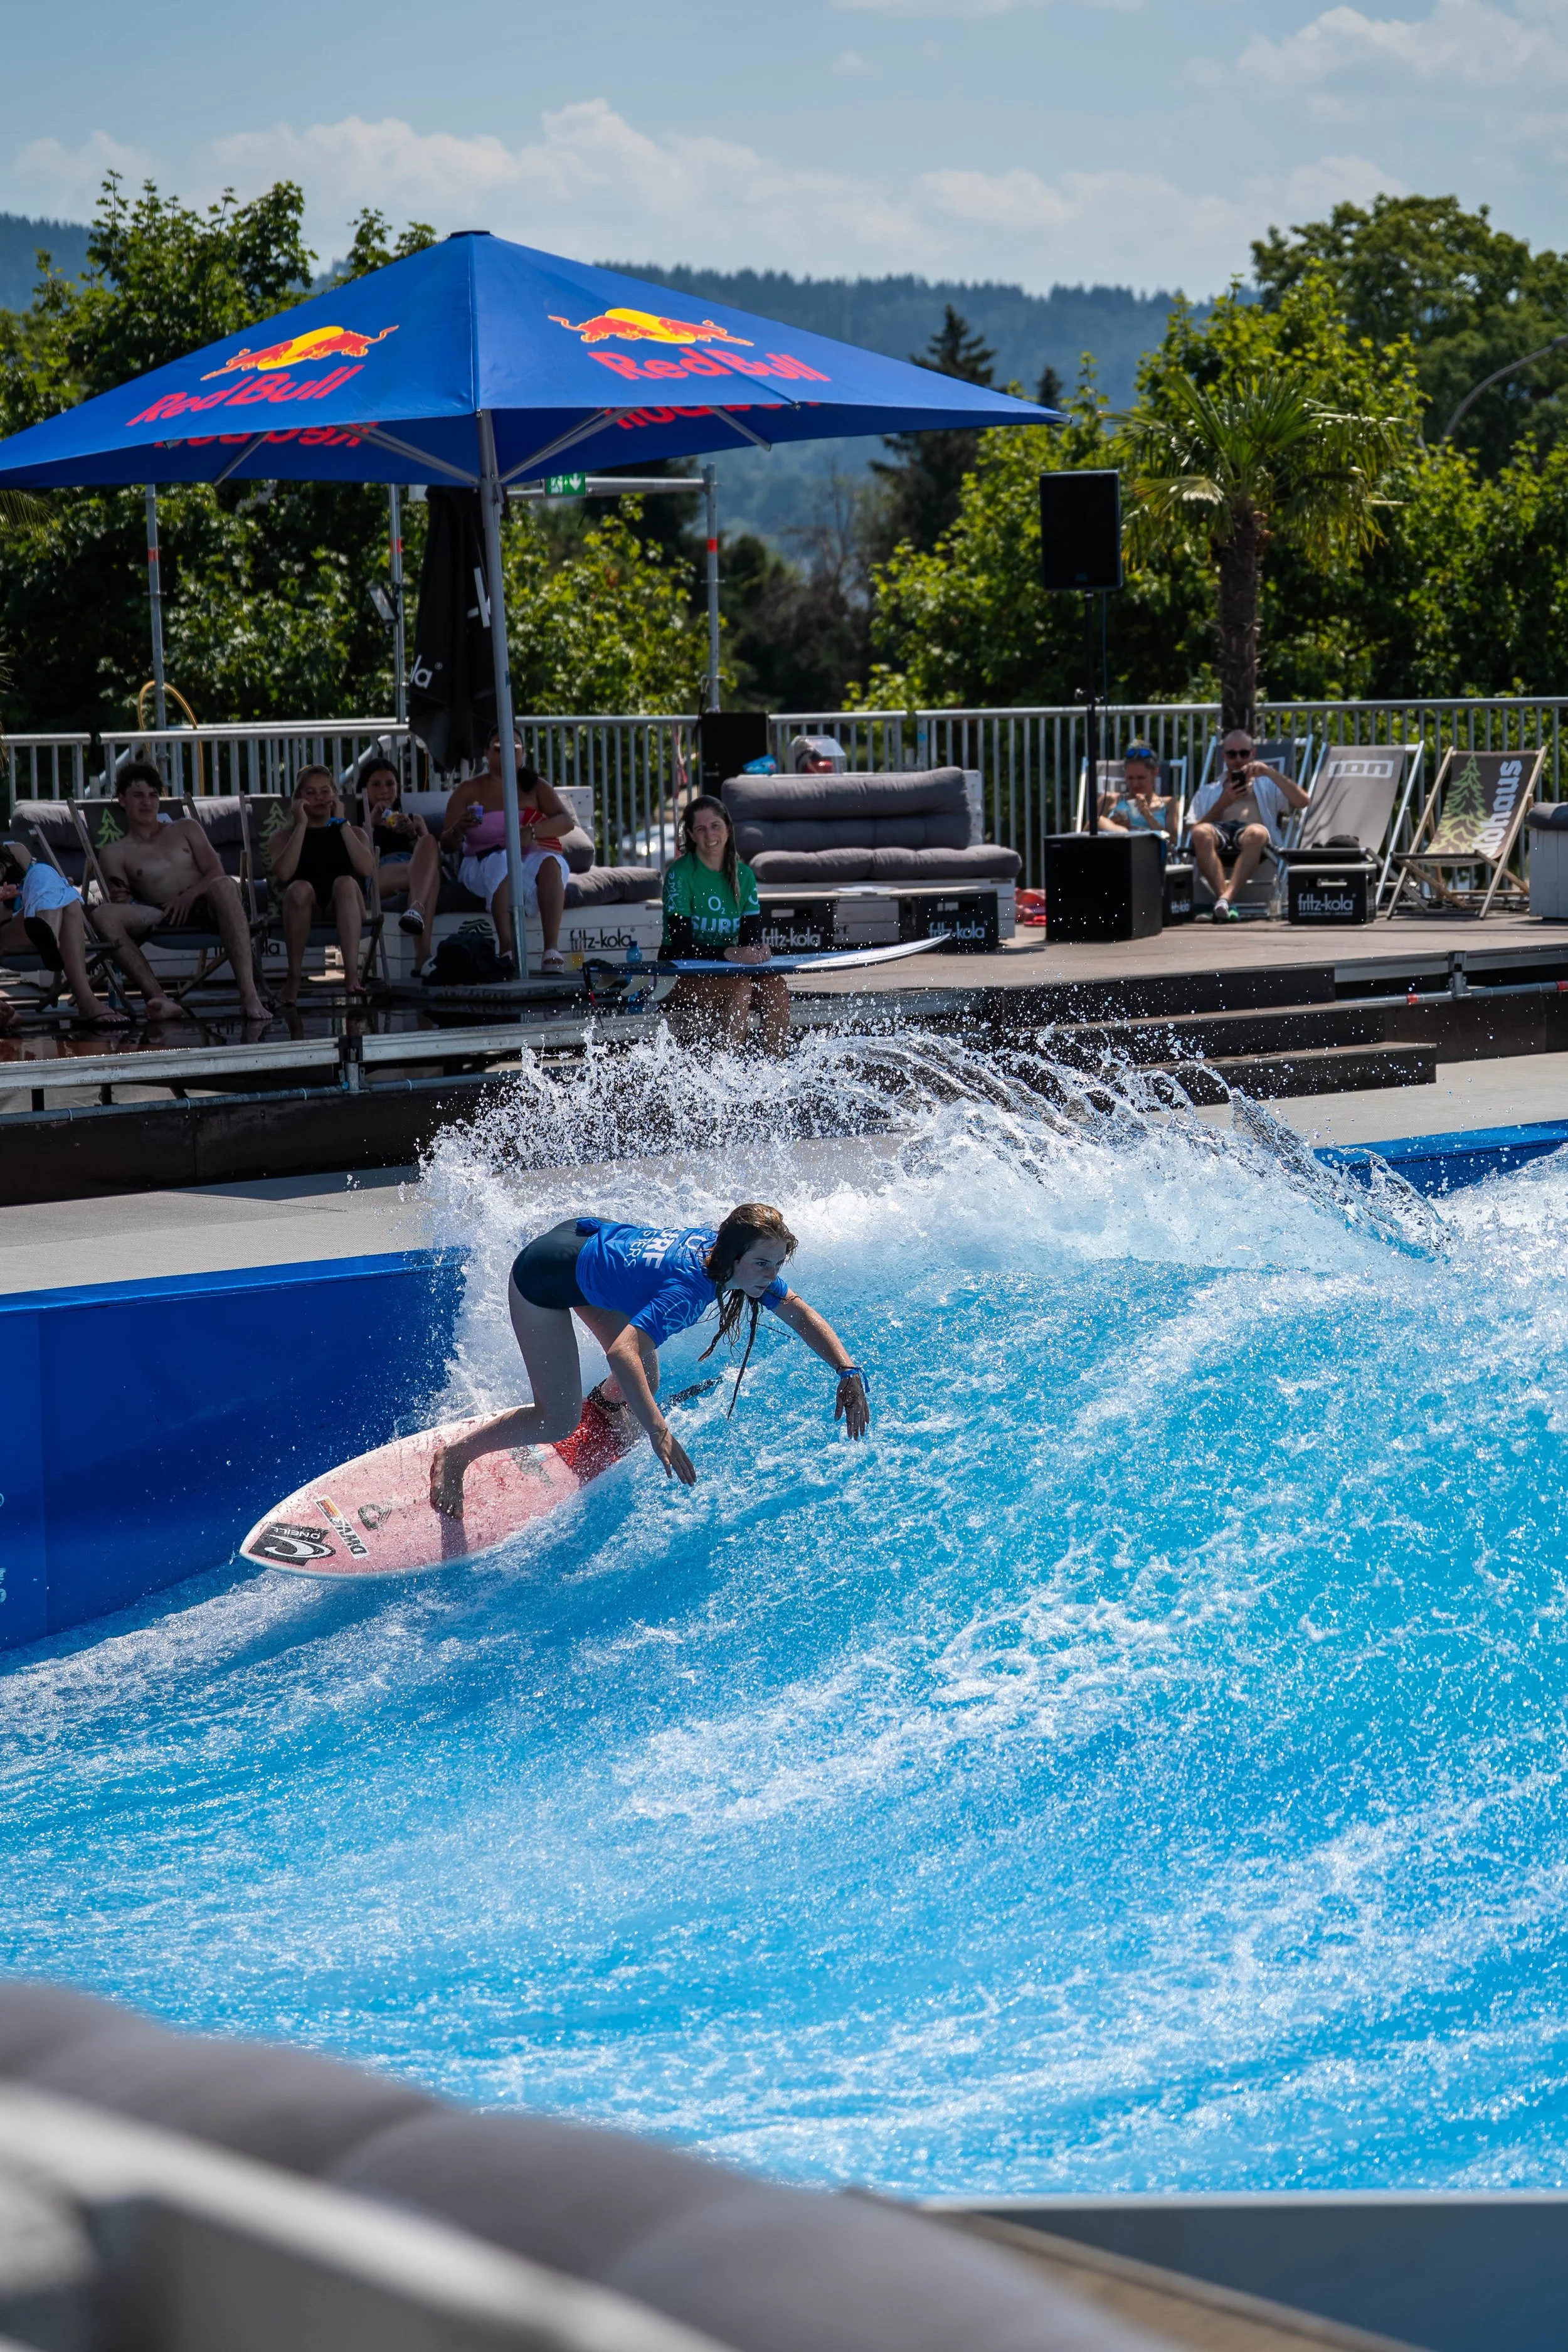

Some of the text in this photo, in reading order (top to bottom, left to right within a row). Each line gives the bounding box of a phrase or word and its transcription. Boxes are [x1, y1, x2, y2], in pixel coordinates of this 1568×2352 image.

[587, 347, 832, 381] Red Bull
[125, 364, 366, 426] Red Bull
